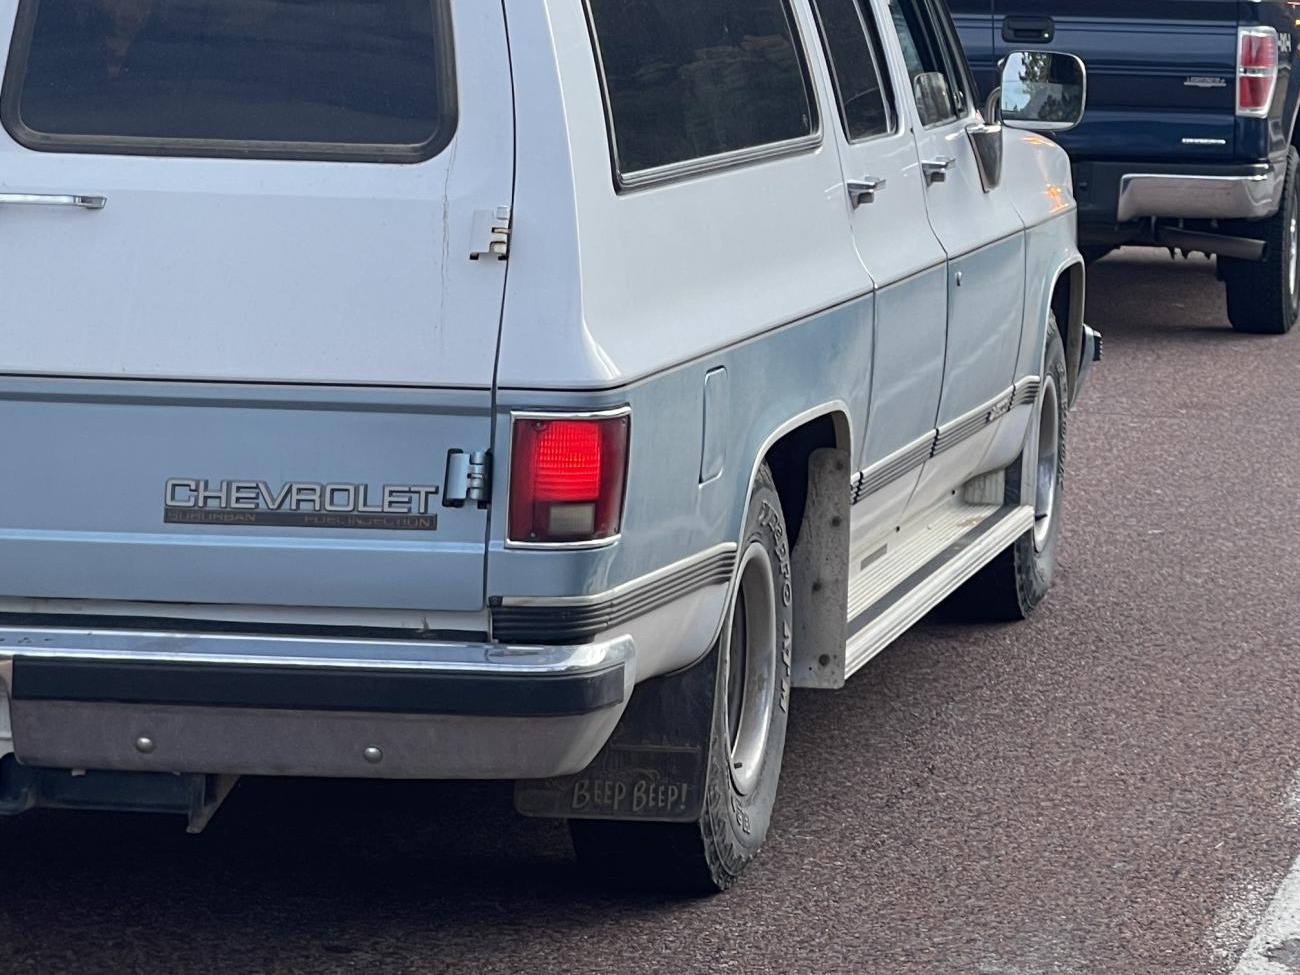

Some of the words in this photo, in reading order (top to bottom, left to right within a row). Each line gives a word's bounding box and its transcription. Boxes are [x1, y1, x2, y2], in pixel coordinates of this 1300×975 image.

[165, 479, 439, 514] CHEVROLET
[167, 511, 257, 523] SUBURBAN
[304, 514, 347, 525] FUEL
[349, 515, 431, 527] INJECTION
[571, 779, 627, 810] BEEP
[632, 780, 688, 812] BEEP!
